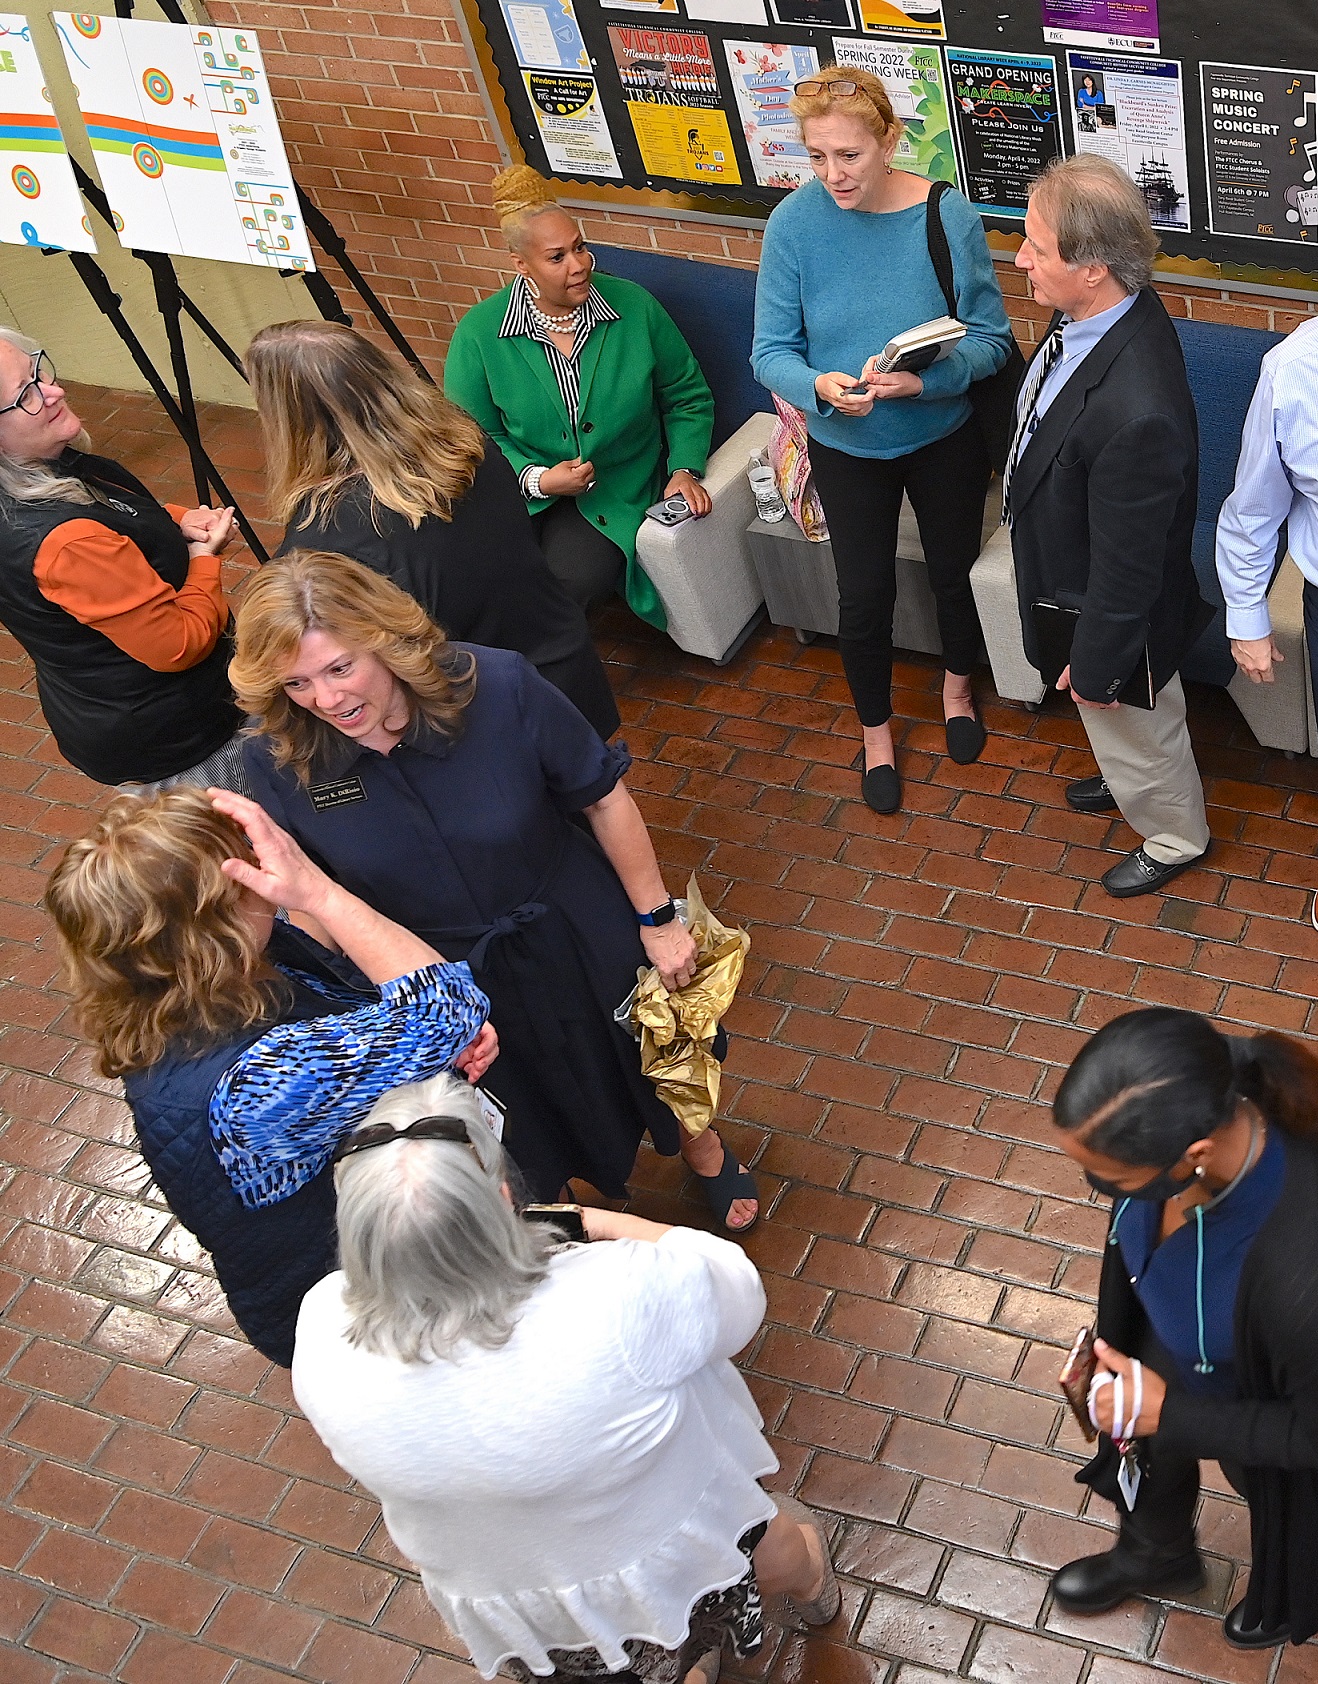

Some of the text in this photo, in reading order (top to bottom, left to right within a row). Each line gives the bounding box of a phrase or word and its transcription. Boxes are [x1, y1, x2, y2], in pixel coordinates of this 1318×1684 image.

[616, 28, 708, 58] VICTORY
[835, 41, 856, 49] Prepare
[1115, 39, 1132, 47] ECU
[0, 51, 17, 73] E
[623, 48, 652, 60] Means
[662, 53, 685, 62] Little
[686, 54, 711, 65] More
[837, 49, 905, 66] SPRING 2022
[915, 55, 932, 67] FTCC
[894, 67, 926, 80] WEEK
[952, 63, 1052, 83] GRAND OPENING
[532, 76, 557, 85] Window
[570, 80, 593, 89] Project
[750, 75, 782, 85] Mother's
[688, 96, 719, 104] SOFTBALL
[957, 86, 1051, 106] MAKERSPACE
[1211, 87, 1264, 102] SPRING
[1212, 103, 1257, 118] MUSIC
[1213, 119, 1280, 136] CONCERT
[1214, 137, 1261, 148] Free Admission
[984, 152, 1006, 161] Monday,
[1217, 187, 1233, 195] April
